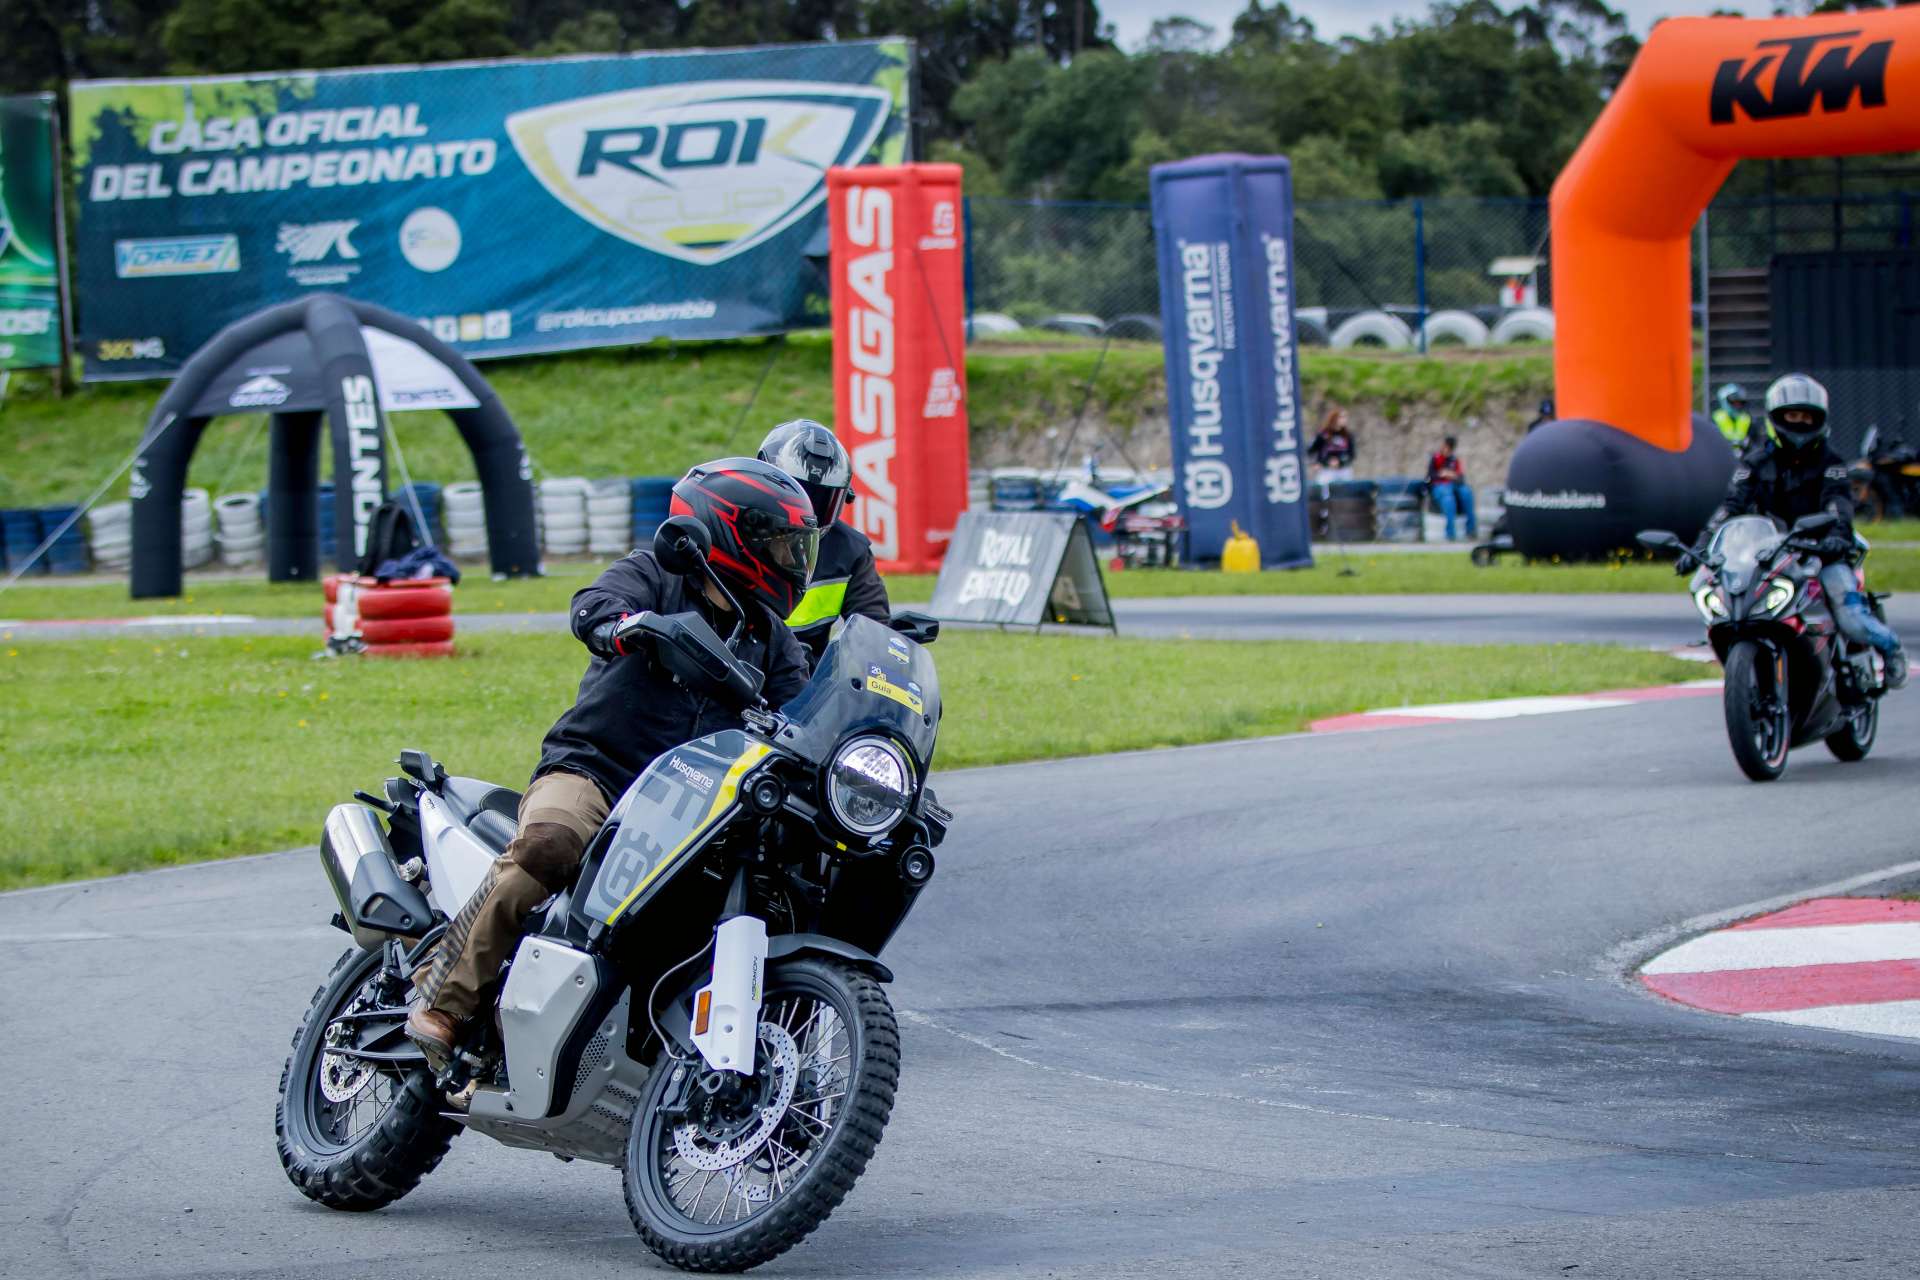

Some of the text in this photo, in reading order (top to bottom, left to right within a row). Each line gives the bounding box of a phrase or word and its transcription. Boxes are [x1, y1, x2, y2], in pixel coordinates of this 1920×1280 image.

[1709, 30, 1894, 125] KTM
[150, 104, 428, 154] CASA OFICIAL
[90, 139, 498, 201] DEL CAMPEONATO
[626, 186, 785, 225] CUP
[846, 184, 898, 562] GASGAS
[1182, 242, 1224, 457] Husqvarna
[1265, 237, 1298, 451] Husqvarna
[669, 755, 714, 789] Husqvarna
